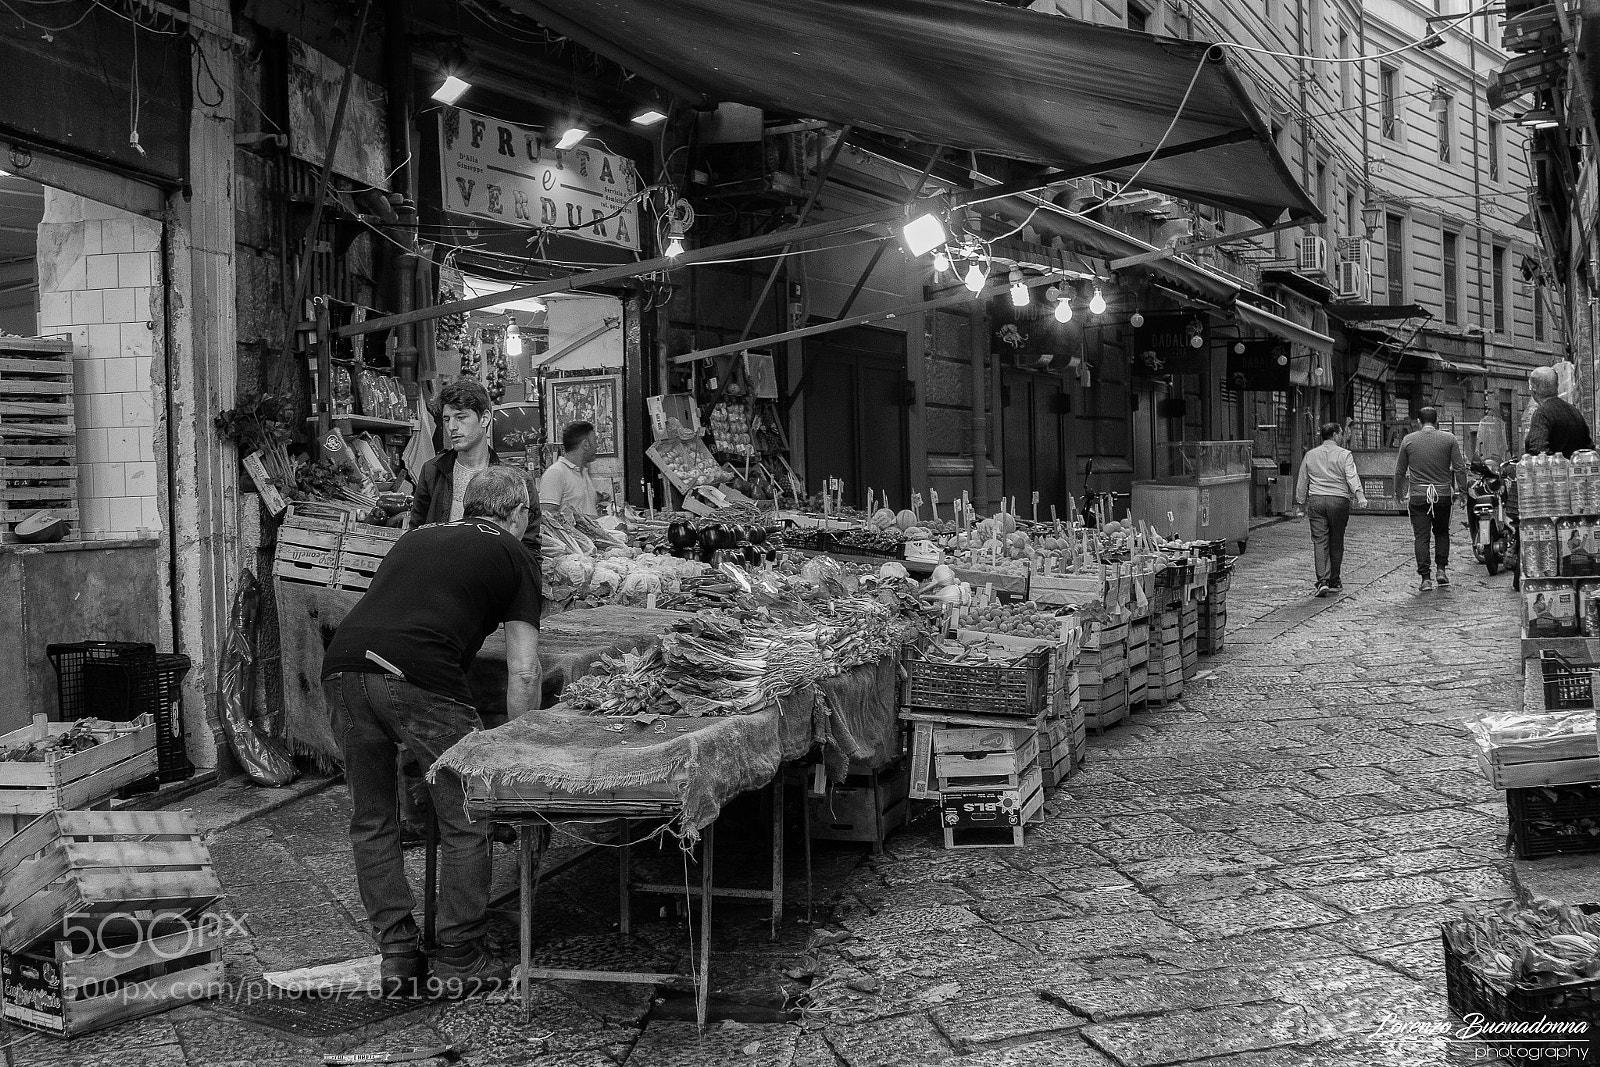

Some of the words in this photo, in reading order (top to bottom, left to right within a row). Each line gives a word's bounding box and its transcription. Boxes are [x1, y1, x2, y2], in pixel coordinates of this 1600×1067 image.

[469, 118, 616, 185] FRUTTA
[542, 169, 556, 191] e
[455, 176, 631, 242] VERDURA
[963, 802, 997, 812] BLS
